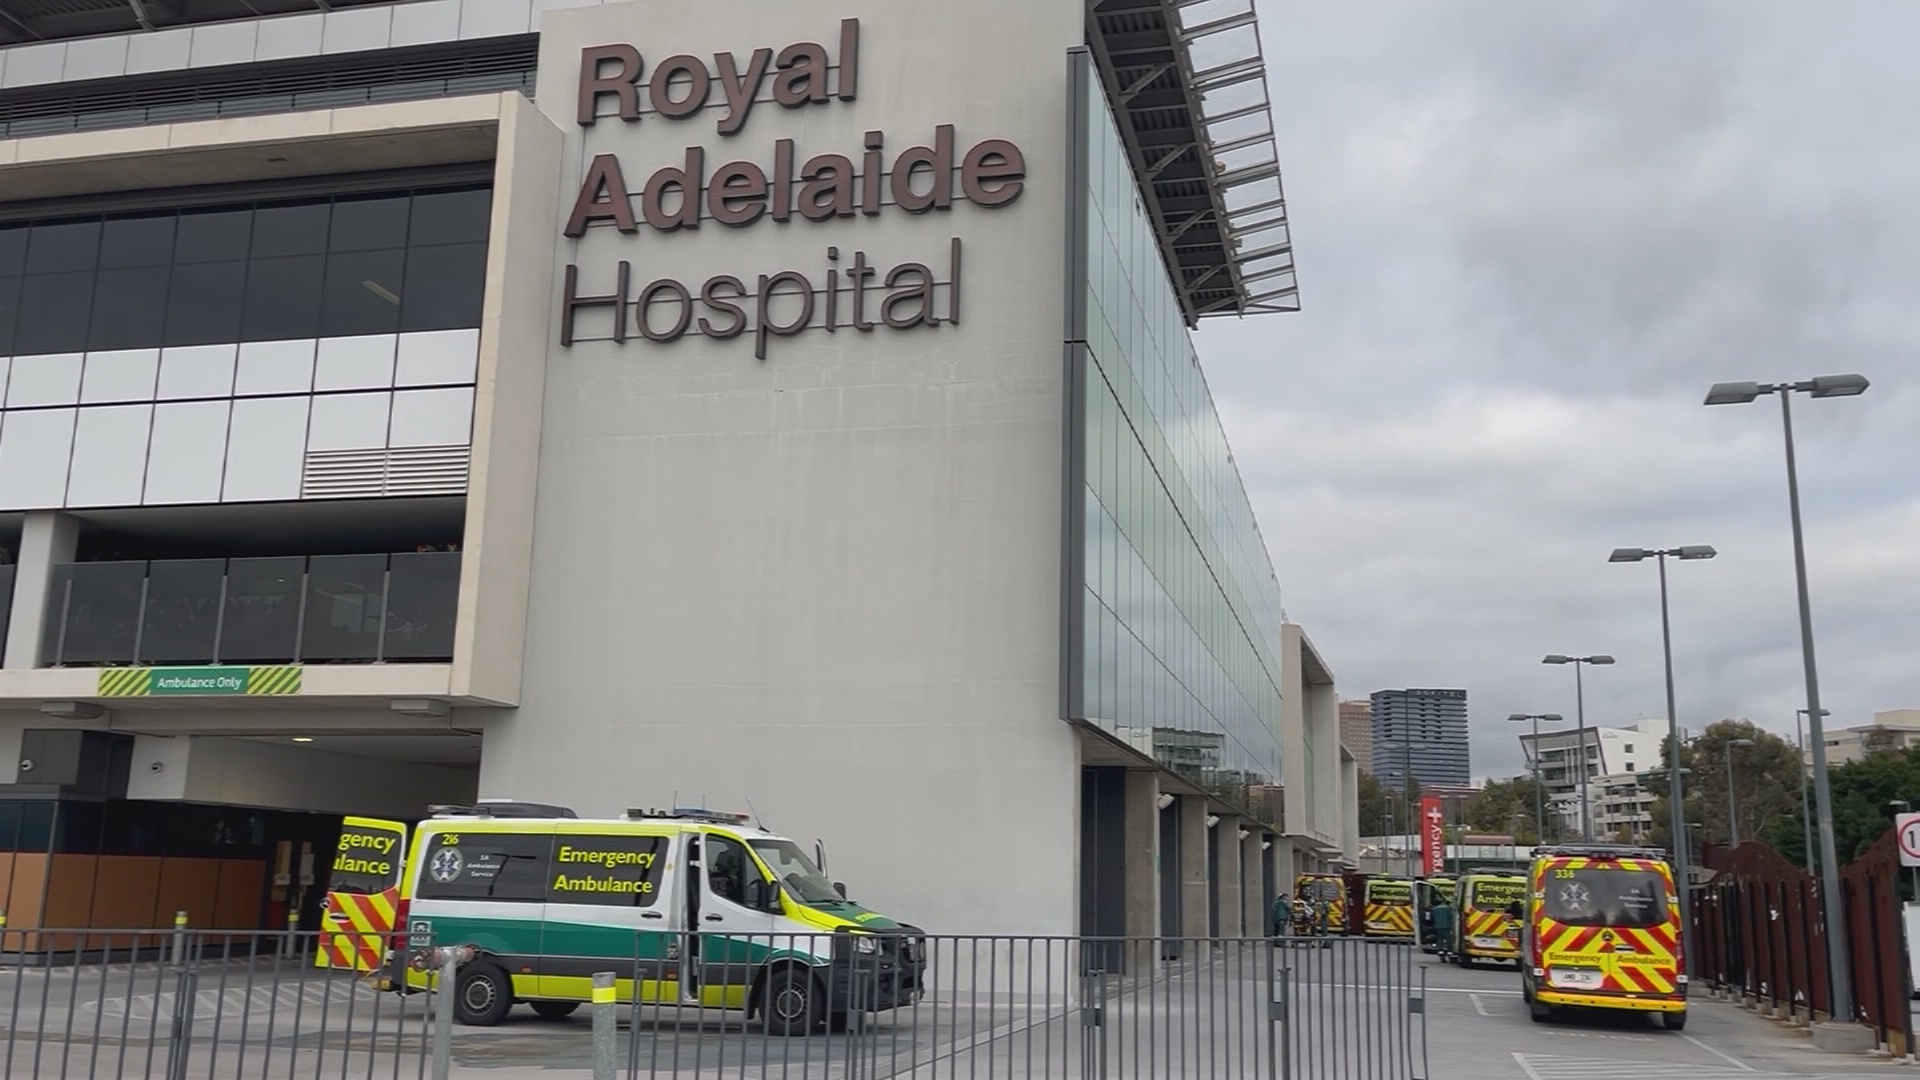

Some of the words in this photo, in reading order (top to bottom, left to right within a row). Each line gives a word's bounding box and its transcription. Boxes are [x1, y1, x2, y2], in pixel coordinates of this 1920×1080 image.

[577, 18, 860, 136] Royal
[564, 124, 1026, 238] Adelaide
[560, 237, 962, 360] Hospital
[157, 677, 215, 688] Ambulance
[216, 677, 242, 690] Only
[559, 846, 656, 869] Emergency
[553, 874, 653, 894] Ambulance
[1555, 869, 1575, 879] 336
[1548, 952, 1602, 964] Emergency
[1615, 955, 1672, 966] Ambulance
